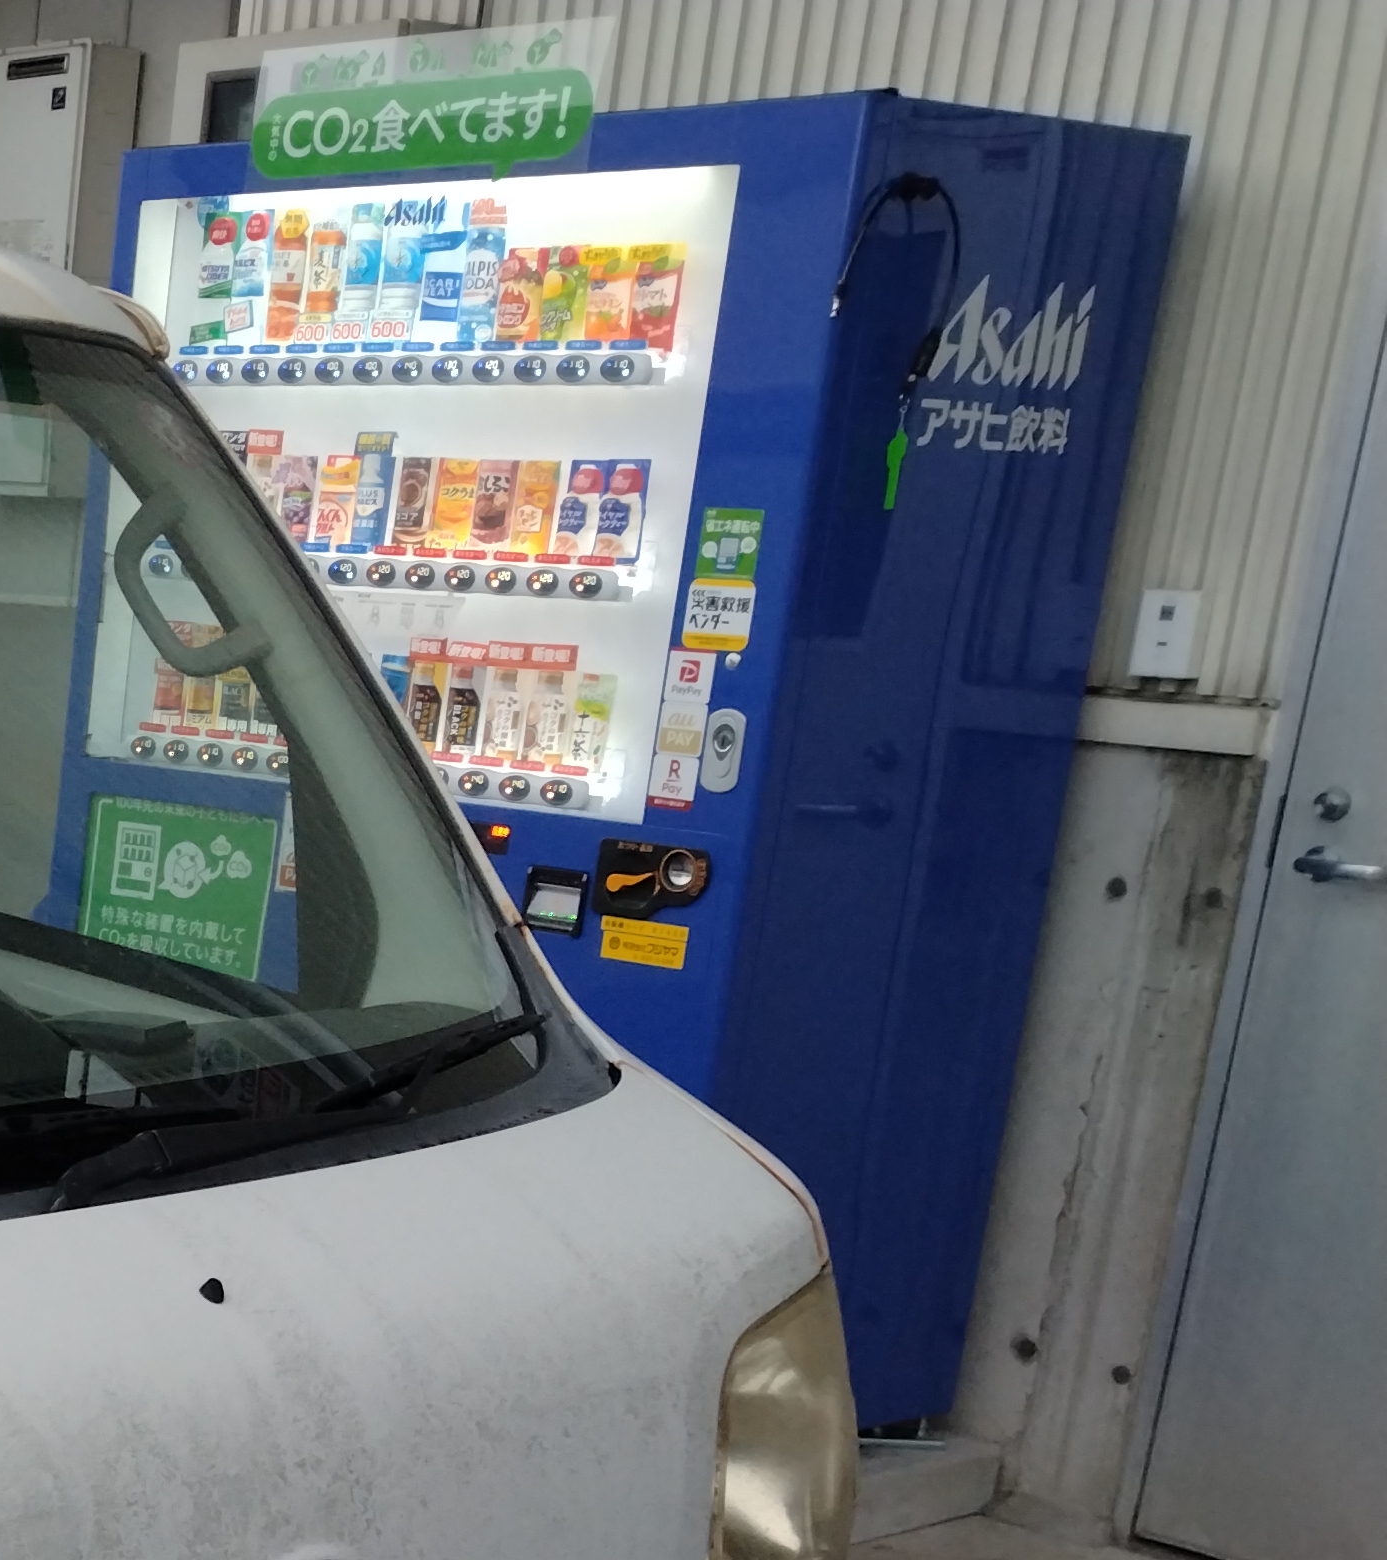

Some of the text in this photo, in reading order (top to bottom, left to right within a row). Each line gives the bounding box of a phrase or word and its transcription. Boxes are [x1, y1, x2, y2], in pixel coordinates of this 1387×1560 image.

[283, 86, 572, 158] CO2食べてます!
[384, 195, 446, 227] Asahi
[465, 261, 498, 276] ALPIS
[465, 276, 495, 290] ODA
[296, 325, 325, 341] 600
[332, 322, 361, 339] 600
[371, 321, 405, 338] 600
[928, 274, 1096, 391] Asahi
[917, 398, 1071, 455] アサヒ飲料
[690, 588, 752, 614] 災害救援
[688, 613, 731, 630] ベンダー
[671, 684, 703, 697] PayPay
[450, 704, 462, 737] BLACK
[668, 711, 696, 727] au
[666, 731, 694, 747] PAY
[669, 760, 681, 778] R
[661, 782, 683, 796] Pay
[101, 904, 246, 944] 特殊な装置を内蔵して
